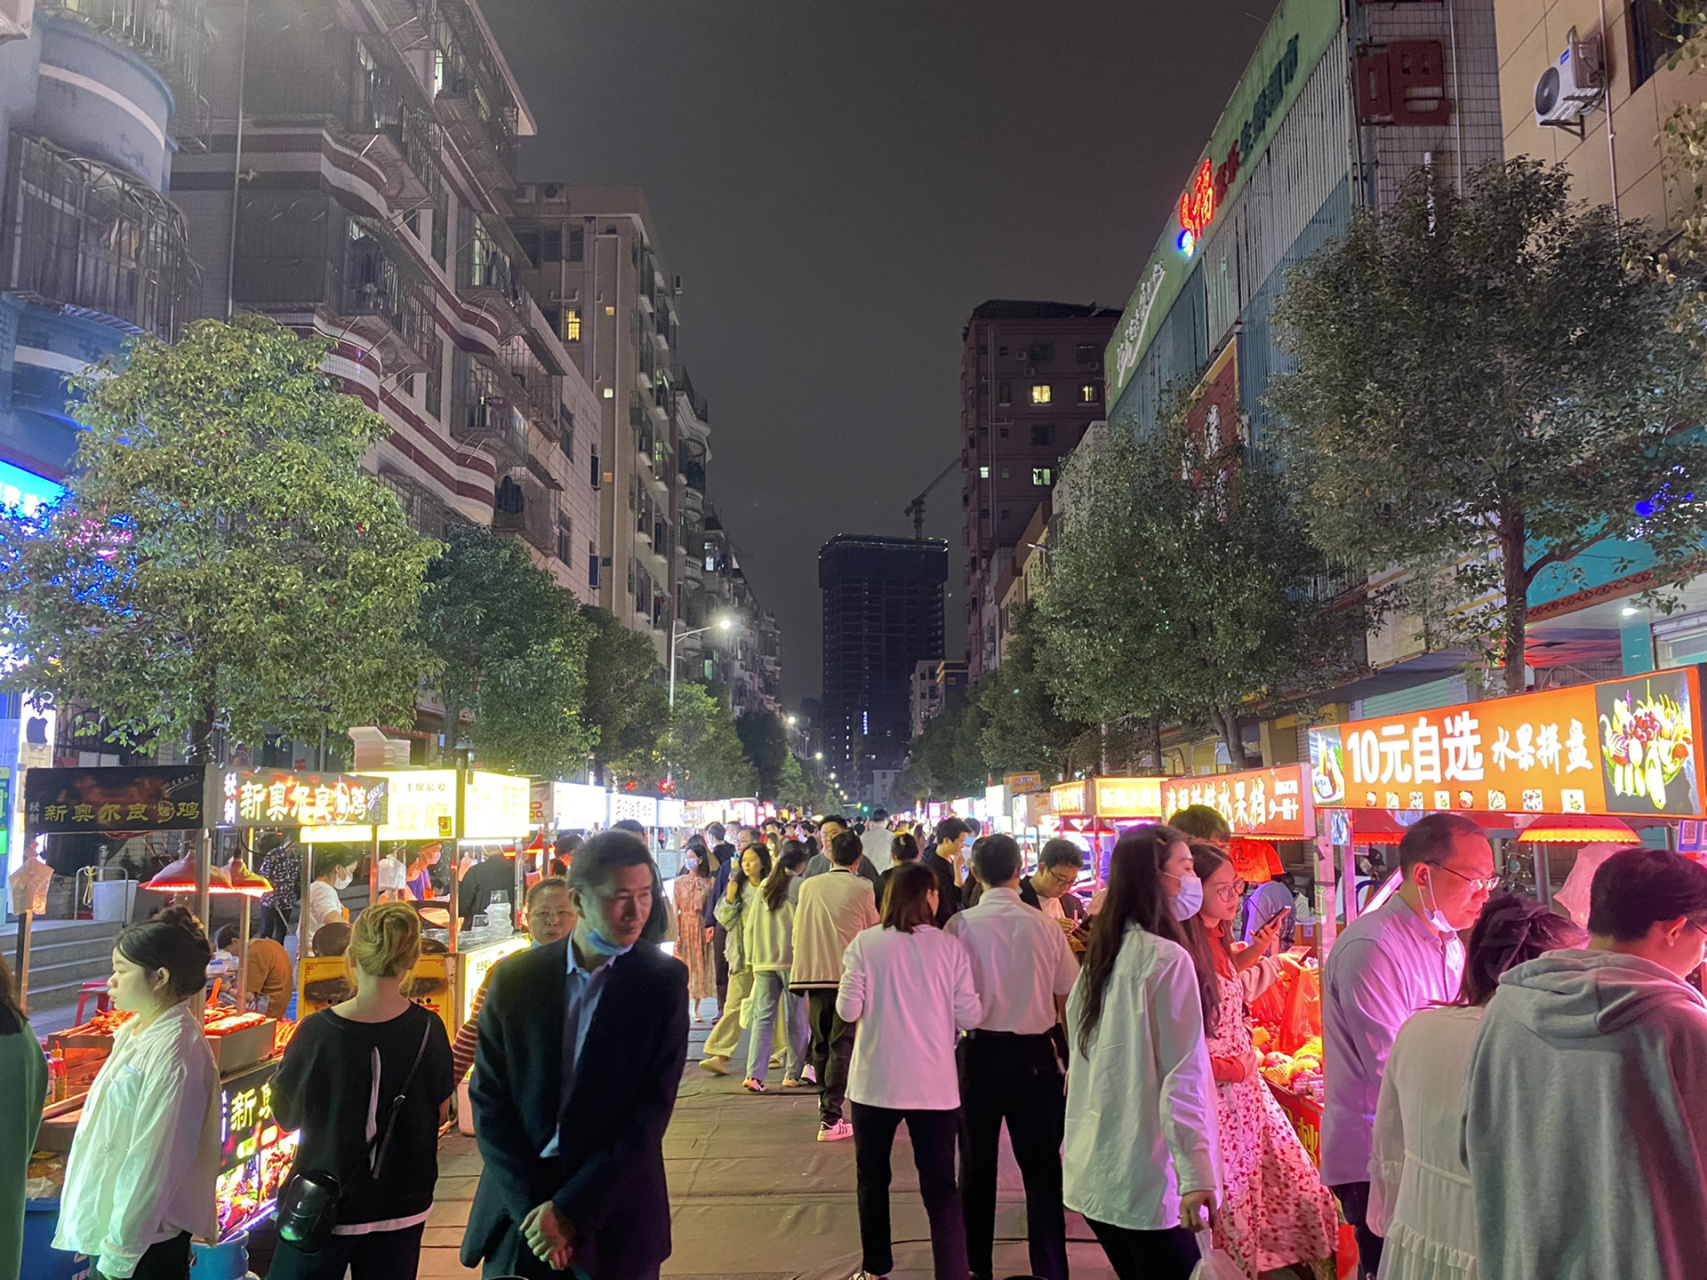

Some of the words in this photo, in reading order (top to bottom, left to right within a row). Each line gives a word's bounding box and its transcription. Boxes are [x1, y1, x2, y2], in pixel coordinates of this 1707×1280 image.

[1346, 711, 1485, 785] 10元自选
[1491, 717, 1594, 775] 水果拼盘
